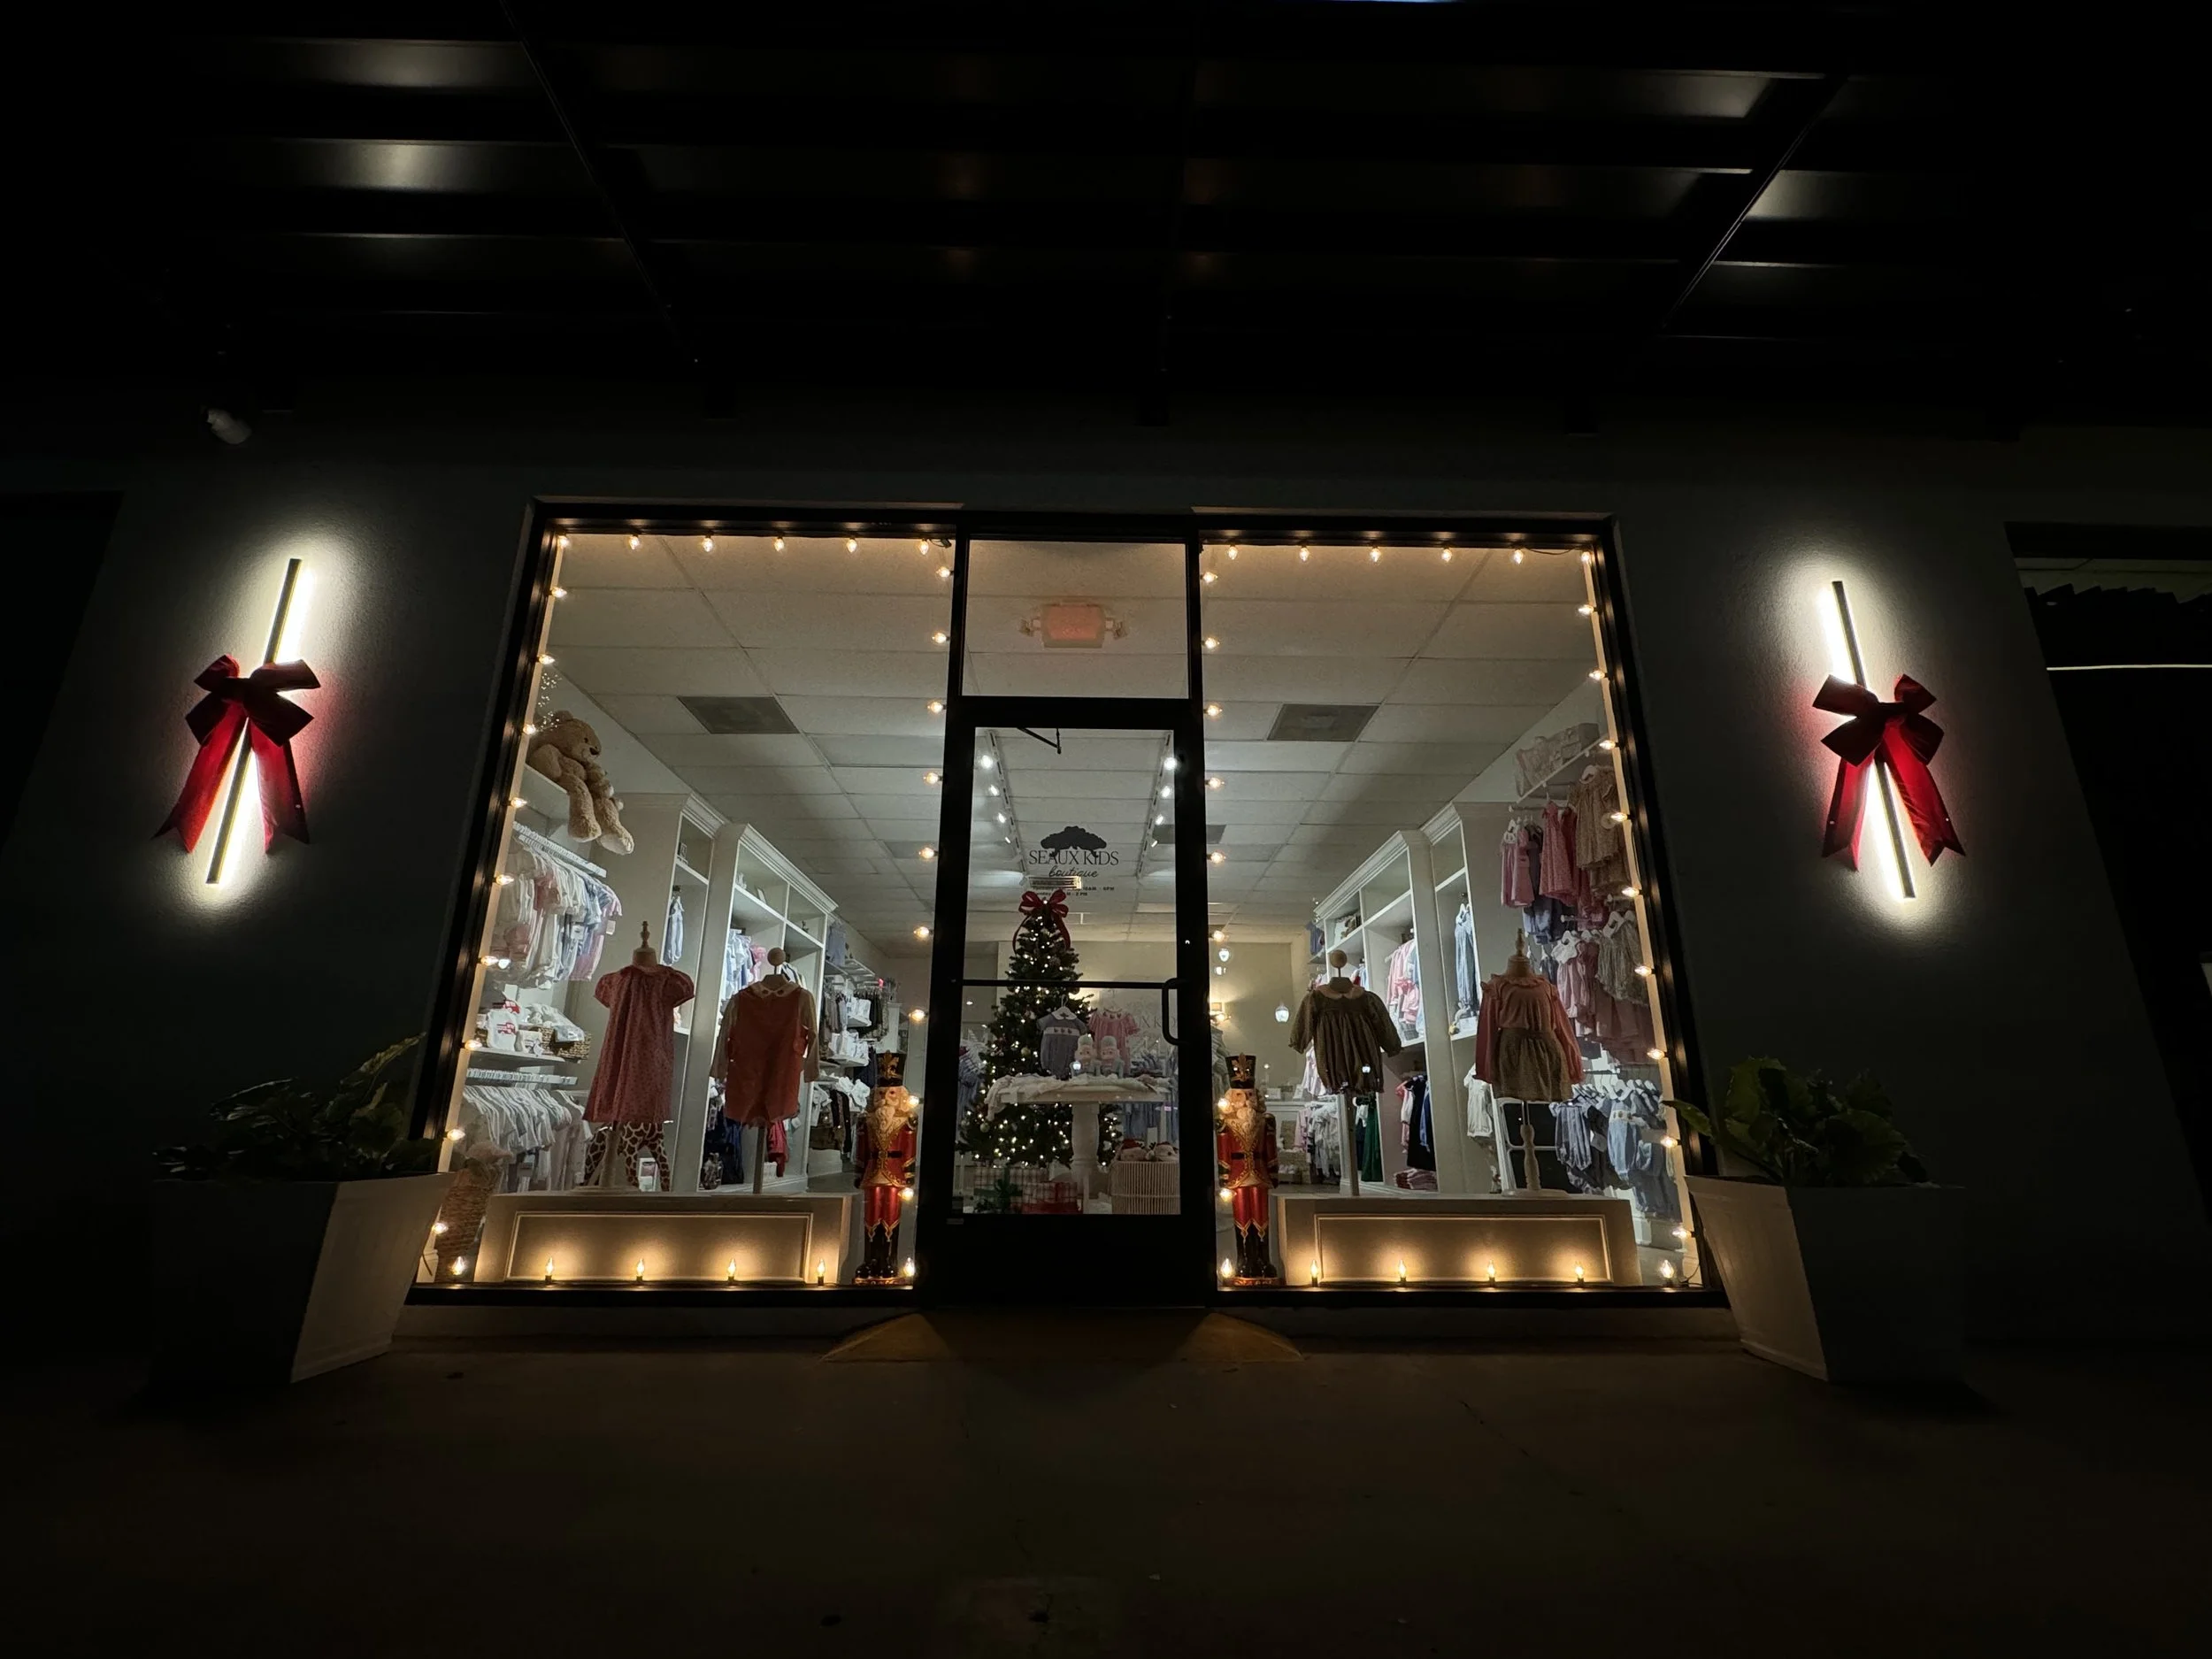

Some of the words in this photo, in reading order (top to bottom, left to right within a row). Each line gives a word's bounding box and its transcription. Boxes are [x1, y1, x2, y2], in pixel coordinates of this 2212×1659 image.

[1028, 850, 1079, 864] SEAUX
[1084, 850, 1119, 866] KIDS
[1048, 865, 1098, 878] boutique
